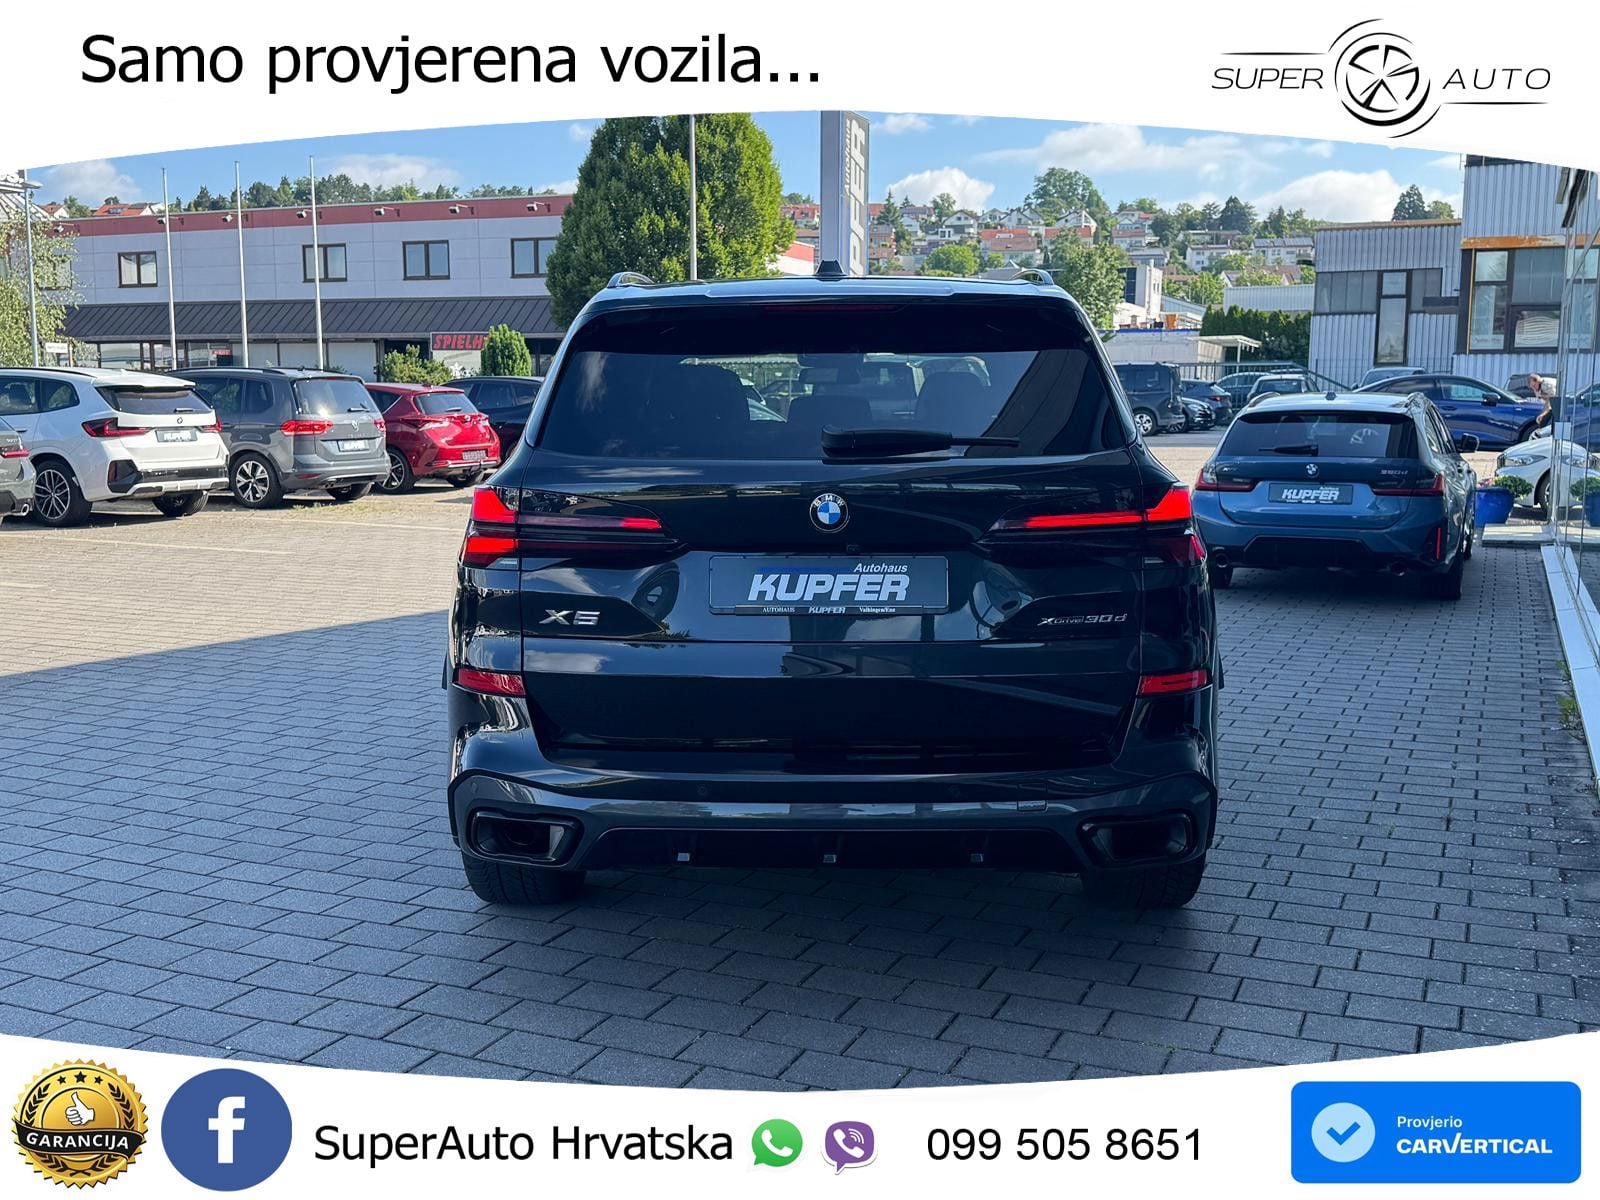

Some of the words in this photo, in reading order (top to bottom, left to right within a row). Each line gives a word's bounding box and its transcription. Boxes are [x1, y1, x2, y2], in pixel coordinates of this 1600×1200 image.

[850, 119, 866, 276] PFER
[433, 335, 491, 350] SPIELH
[1281, 489, 1340, 500] KUPFER
[853, 562, 908, 573] Autohaus
[748, 574, 910, 601] KUPFER
[538, 609, 601, 625] X5
[808, 606, 846, 614] KUPFER
